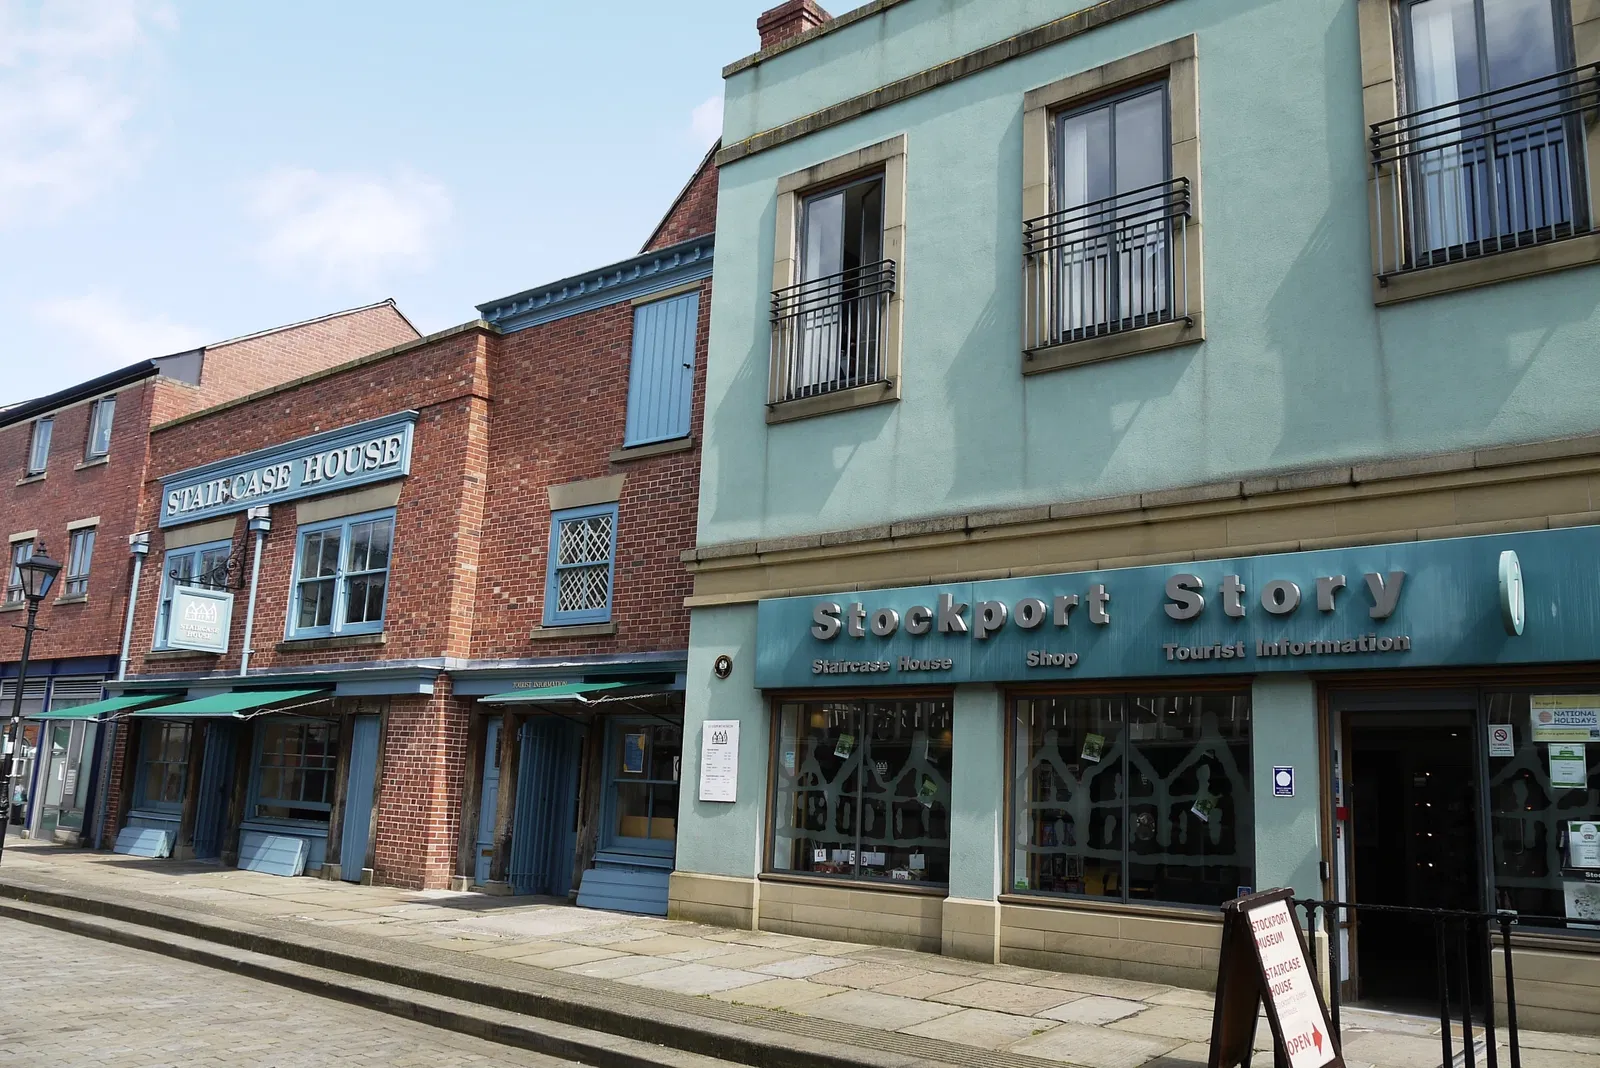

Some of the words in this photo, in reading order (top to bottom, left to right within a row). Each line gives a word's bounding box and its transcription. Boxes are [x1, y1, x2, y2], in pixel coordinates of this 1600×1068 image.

[166, 461, 292, 517] STAIRCASE
[300, 435, 402, 484] HOUSE
[811, 584, 1110, 640] Stockport
[1164, 570, 1406, 620] Story
[1162, 640, 1246, 661] Tourist
[1256, 632, 1411, 657] Information
[812, 659, 890, 674] Staircase
[897, 656, 952, 672] House
[1026, 650, 1079, 669] Shop
[1251, 911, 1289, 933] STOCKPORT
[1256, 930, 1285, 950] MUSEUM
[1264, 957, 1301, 981] STAIRCASE
[1269, 979, 1293, 999] HOUSE
[1286, 1031, 1312, 1056] OPEN
